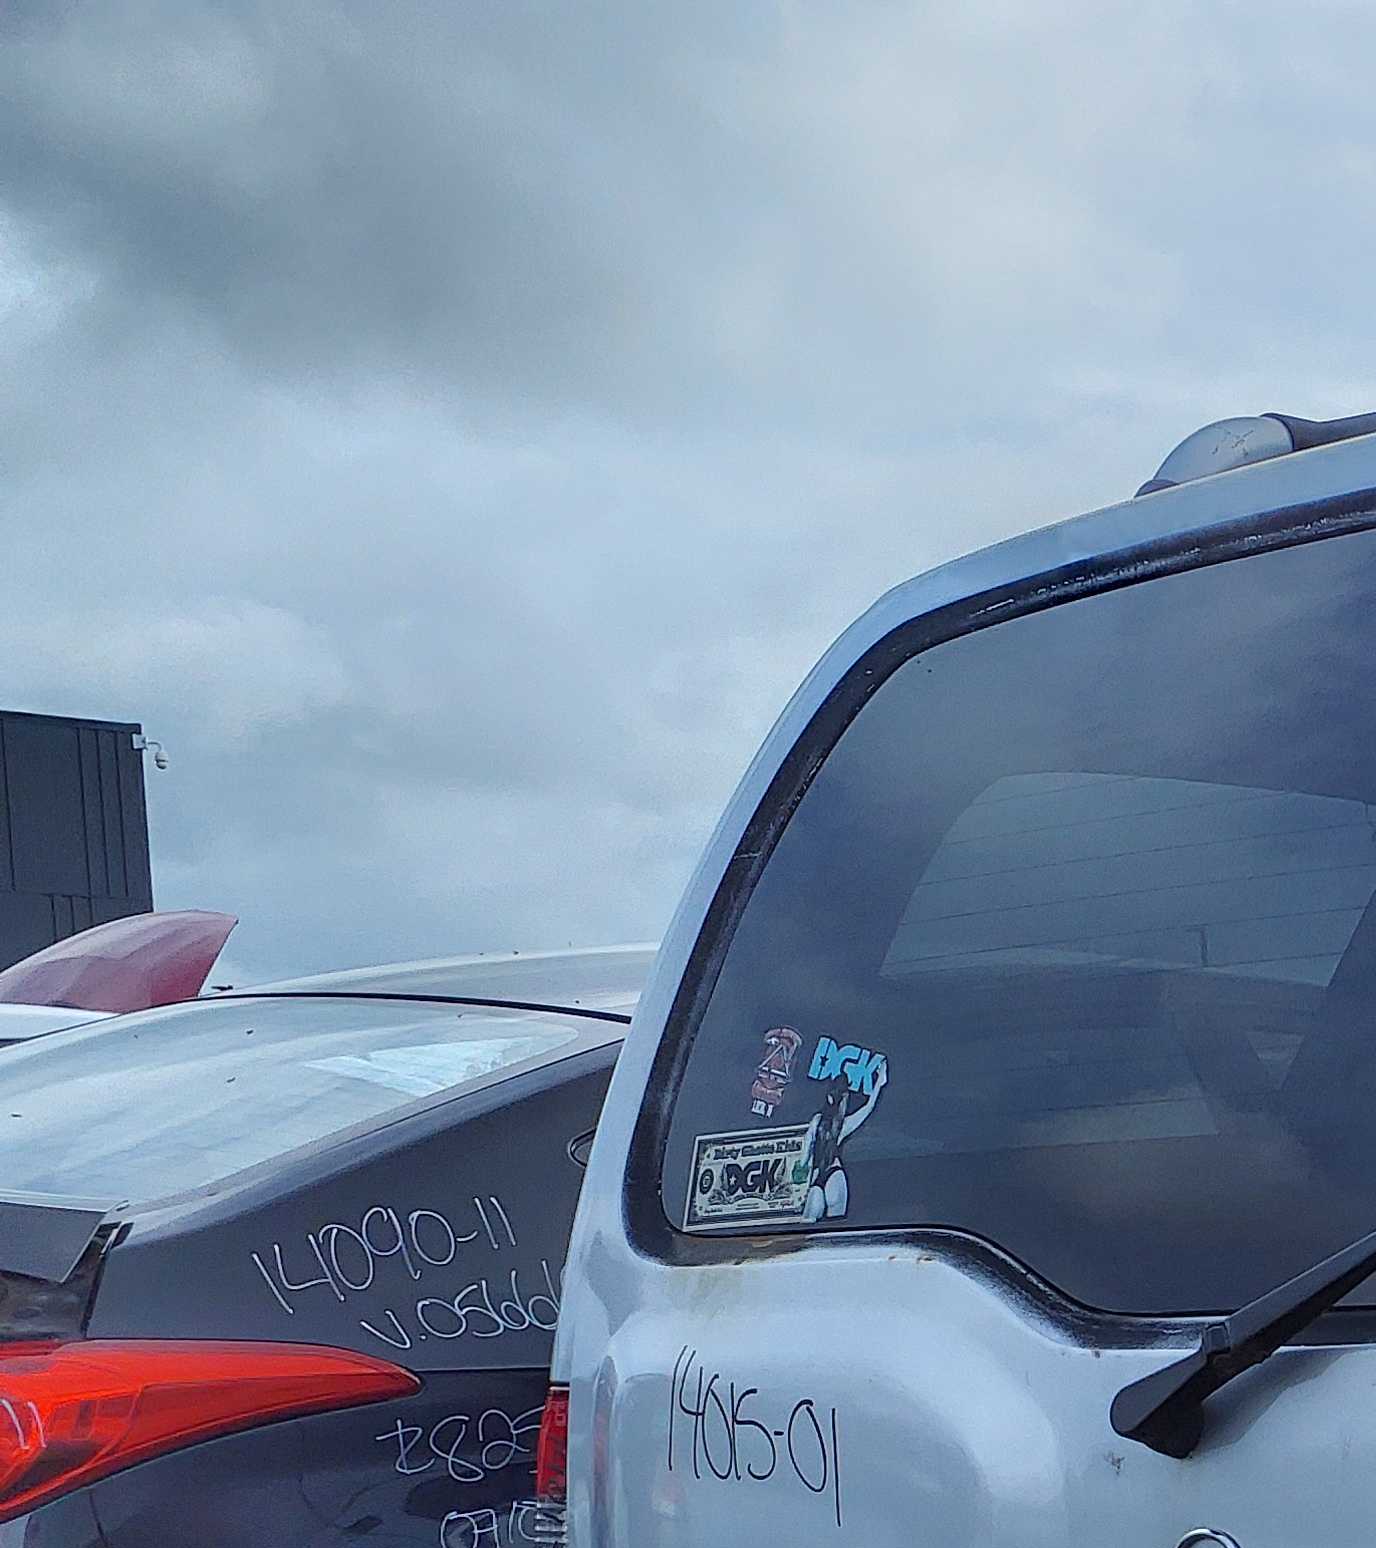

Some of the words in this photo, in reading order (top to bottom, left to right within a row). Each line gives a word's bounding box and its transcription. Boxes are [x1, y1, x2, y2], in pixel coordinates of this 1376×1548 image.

[808, 1035, 888, 1096] DGK
[724, 1158, 784, 1196] DGK
[251, 1196, 516, 1314] 14090-11
[668, 1344, 842, 1527] 14015-01
